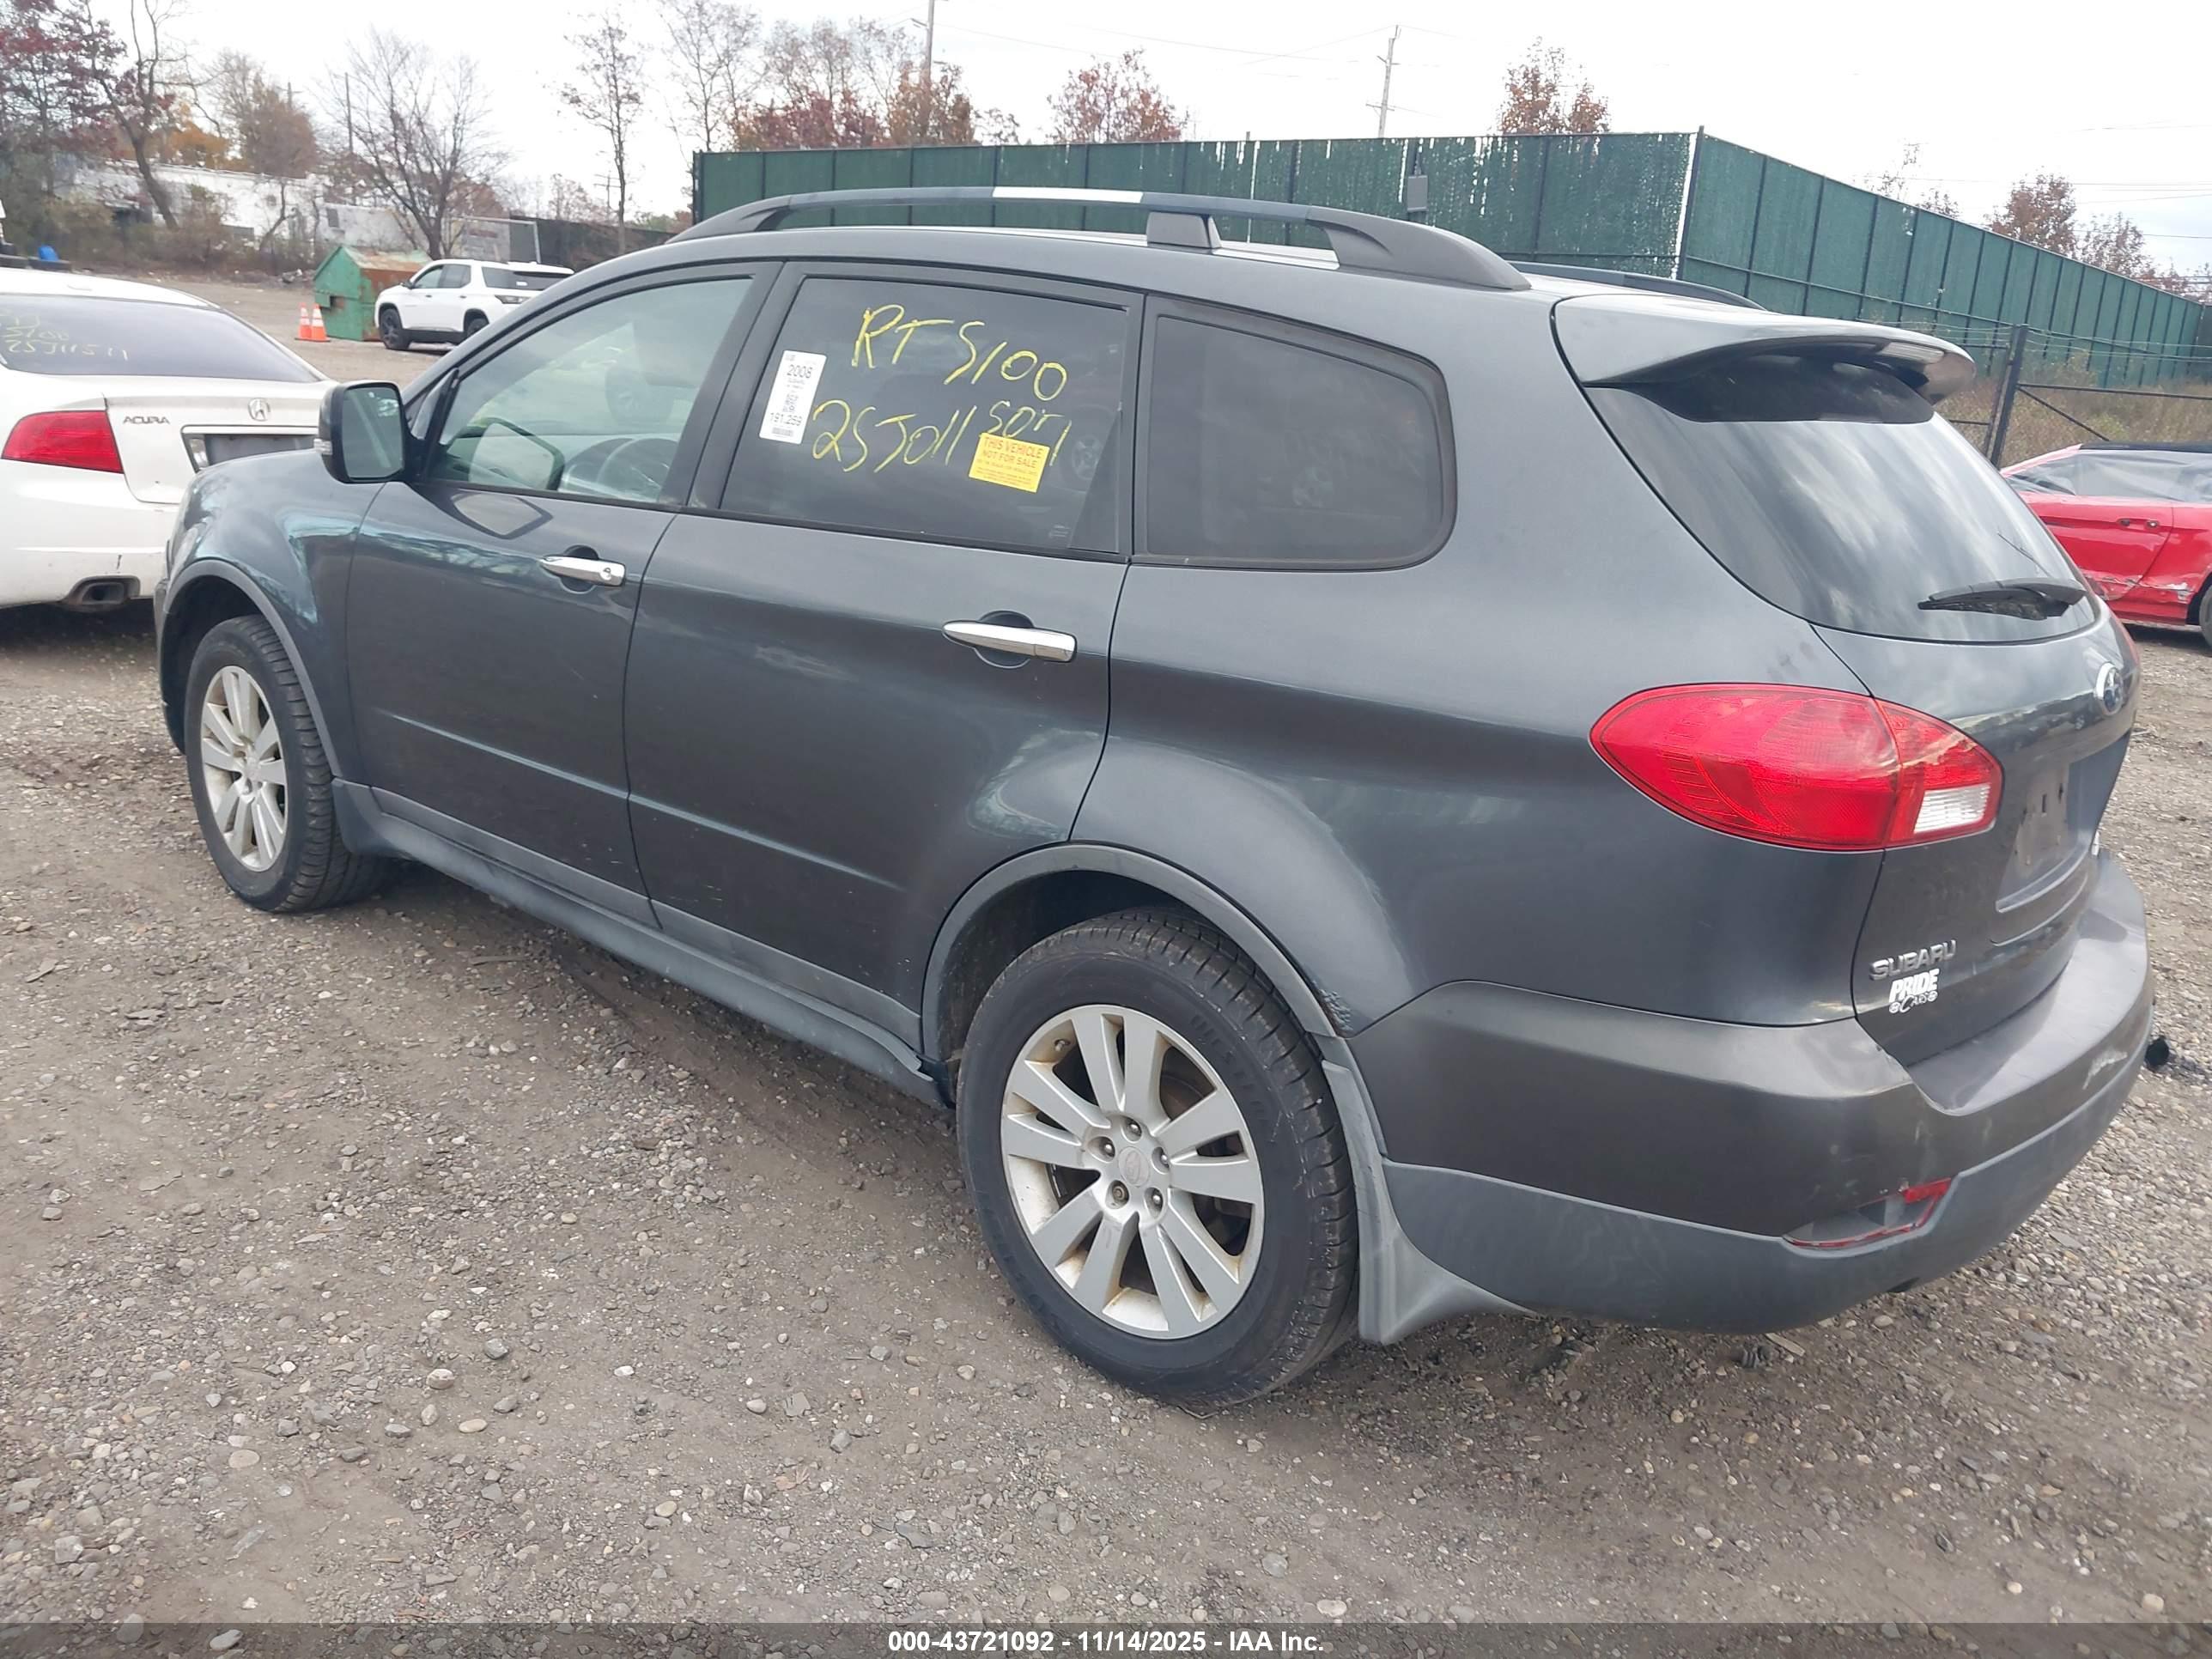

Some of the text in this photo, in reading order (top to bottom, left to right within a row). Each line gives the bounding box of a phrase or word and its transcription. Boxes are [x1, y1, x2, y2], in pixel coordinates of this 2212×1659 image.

[123, 416, 171, 424] ACURA
[982, 435, 1044, 459] THIS VEHICLE
[1016, 456, 1038, 469] SALE
[1869, 939, 1957, 980] SUBARU
[1889, 969, 1940, 1003] PRIDE
